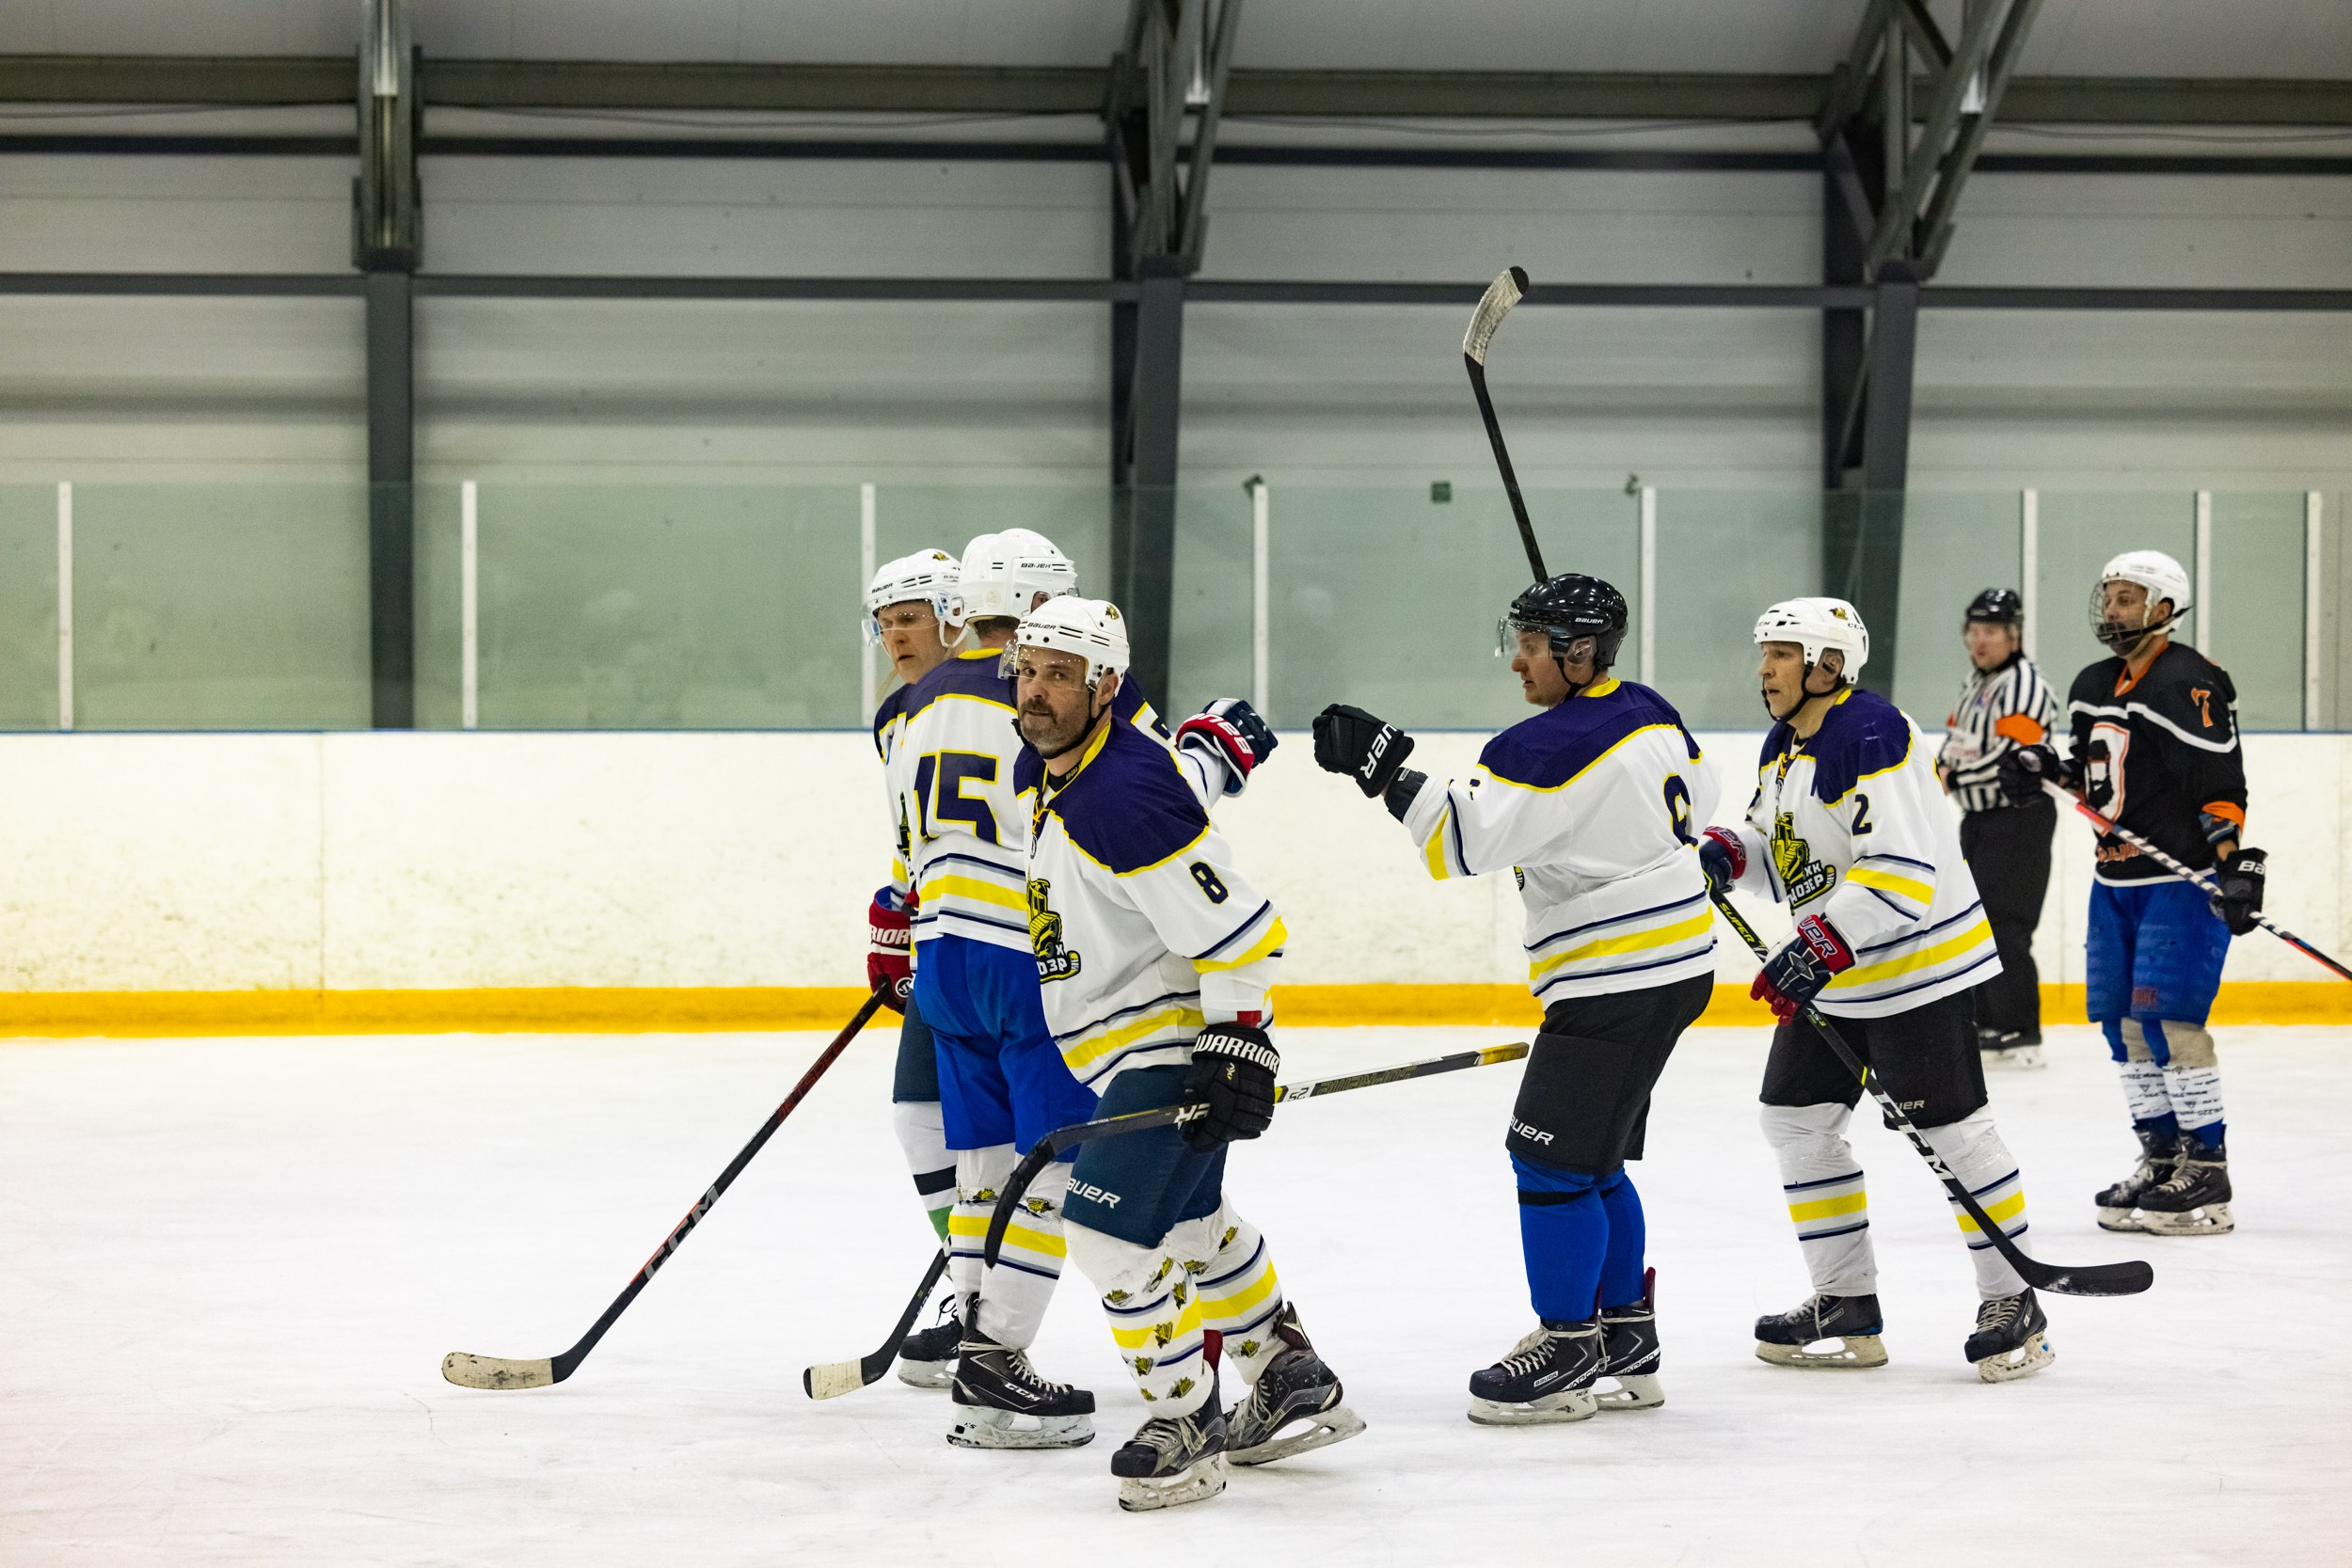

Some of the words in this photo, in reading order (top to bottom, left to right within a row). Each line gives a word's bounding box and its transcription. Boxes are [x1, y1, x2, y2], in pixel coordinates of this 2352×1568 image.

[2191, 688, 2213, 728] 7
[914, 750, 1000, 846] 15
[1851, 793, 1872, 836] 2
[1188, 861, 1230, 906] 8
[1719, 902, 1756, 942] SUPER
[1192, 1034, 1280, 1075] WARRIOR
[644, 1185, 720, 1280] CCM
[1004, 1382, 1041, 1402] CCM
